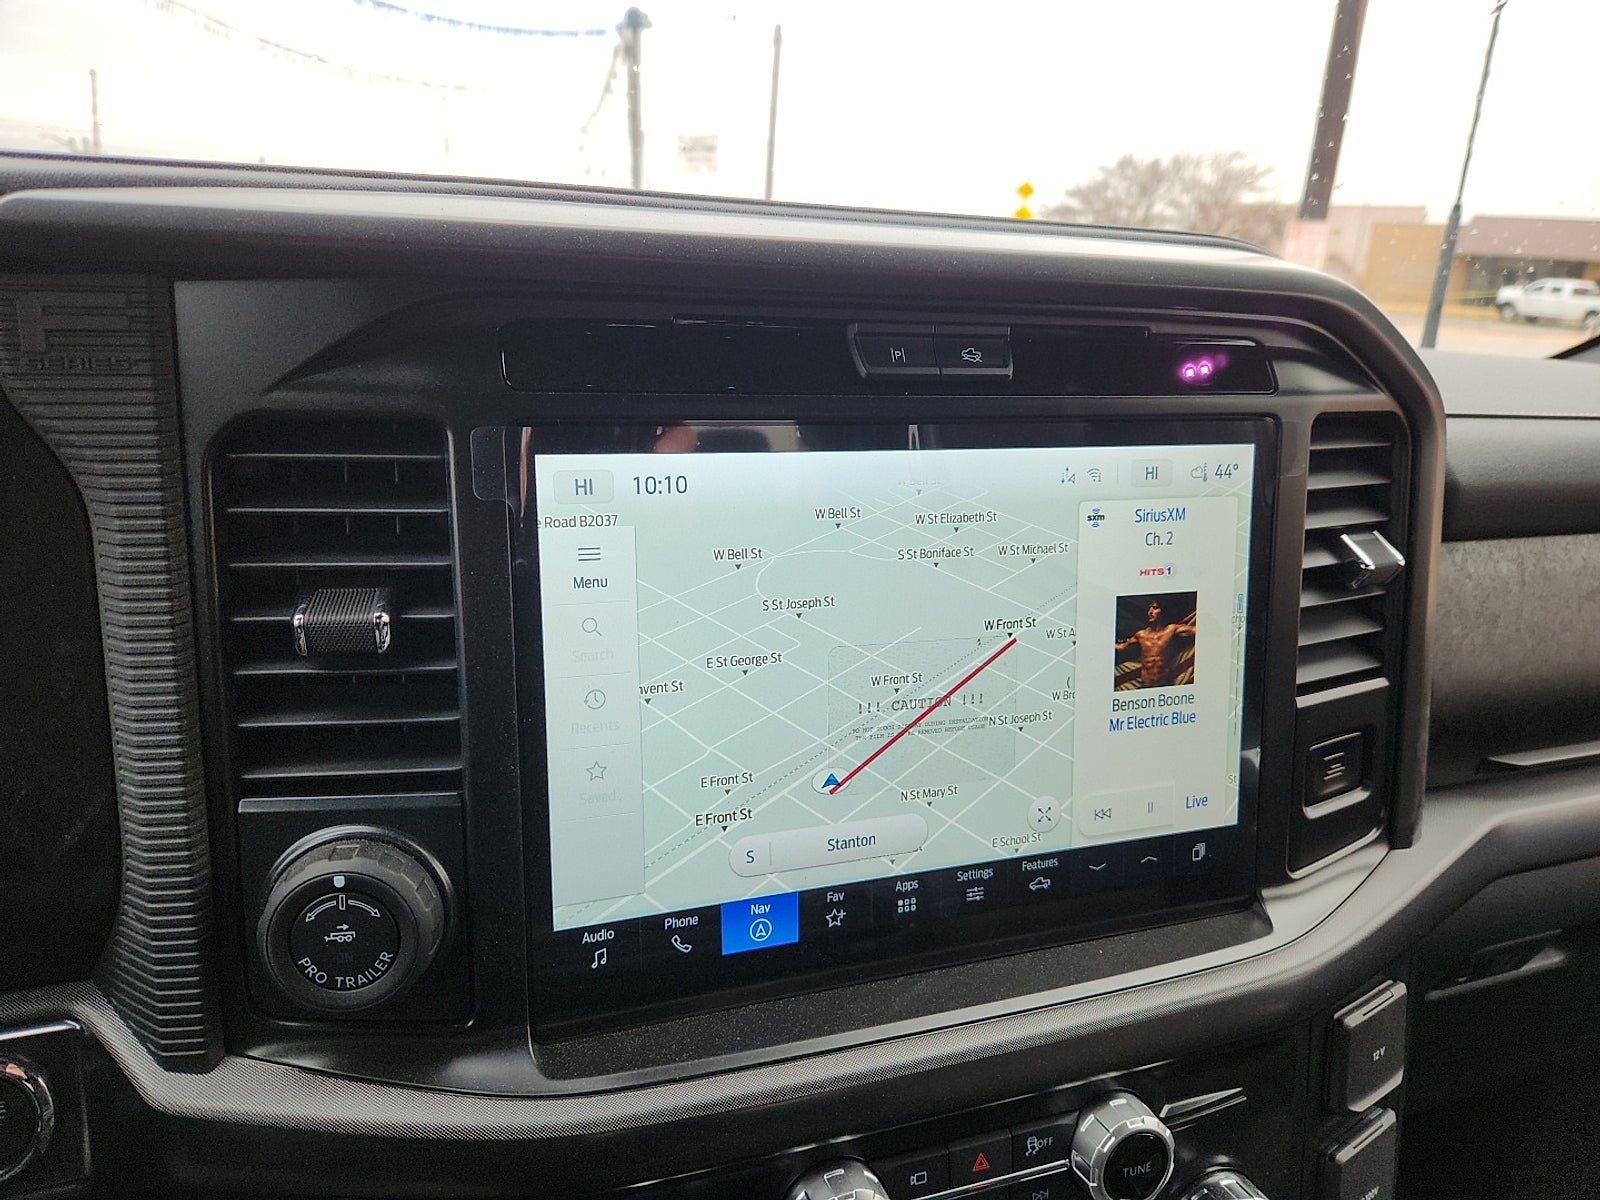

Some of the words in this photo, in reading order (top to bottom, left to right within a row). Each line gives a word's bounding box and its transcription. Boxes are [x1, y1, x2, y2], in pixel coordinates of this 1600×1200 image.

[1145, 466, 1158, 480] HI
[1214, 463, 1239, 479] 44°
[575, 478, 593, 495] HI
[633, 475, 688, 495] 10:10
[814, 508, 825, 519] W
[827, 507, 848, 519] Bell
[850, 506, 862, 518] St
[915, 513, 926, 525] W
[928, 513, 939, 524] St
[941, 512, 985, 524] Elizabeth
[986, 511, 998, 522] St
[1087, 513, 1105, 522] sxm
[1134, 507, 1186, 523] SiriusXM
[544, 515, 577, 529] Road
[579, 514, 618, 528] B2037
[1145, 532, 1164, 546] Ch.
[1166, 531, 1174, 545] 2
[713, 549, 726, 561] W
[727, 548, 749, 560] Bell
[750, 547, 763, 559] St
[898, 549, 904, 560] S
[906, 549, 918, 560] St
[920, 547, 961, 559] Boniface
[963, 546, 975, 557] St
[998, 544, 1009, 555] W
[1010, 544, 1021, 555] St
[1023, 543, 1056, 554] Michael
[1058, 542, 1069, 553] St
[573, 576, 608, 590] Menu
[763, 600, 769, 611] S
[771, 600, 784, 611] St
[785, 597, 820, 612] Joseph
[822, 596, 836, 608] St
[984, 619, 996, 631] W
[997, 618, 1023, 630] Front
[1025, 617, 1037, 628] St
[1046, 629, 1056, 639] W
[1057, 628, 1067, 638] St
[1068, 627, 1076, 637] A
[706, 657, 714, 669] E
[717, 657, 729, 668] St
[731, 654, 768, 669] George
[771, 652, 783, 664] St
[671, 680, 684, 692] St
[871, 676, 883, 687] W
[883, 674, 910, 686] Front
[911, 672, 923, 683] St
[1052, 690, 1061, 701] W
[1112, 697, 1156, 713] Benson
[1157, 694, 1195, 709] Boone
[988, 715, 996, 726] N
[997, 714, 1008, 726] St
[1009, 712, 1040, 726] Joseph
[1041, 711, 1053, 721] St
[1109, 718, 1125, 732] Mr
[1127, 715, 1170, 731] Electric
[1171, 711, 1196, 726] Blue
[701, 778, 708, 789] E
[710, 775, 741, 787] Front
[742, 772, 753, 783] St
[1227, 774, 1237, 784] St
[900, 790, 908, 801] N
[910, 790, 921, 800] St
[923, 787, 946, 802] Mary
[947, 785, 959, 796] St
[1185, 794, 1208, 809] Live
[695, 814, 703, 826] E
[705, 811, 738, 825] Front
[739, 808, 753, 820] St
[827, 834, 876, 852] Stanton
[992, 837, 998, 848] E
[1000, 834, 1030, 847] School
[1031, 832, 1041, 843] St
[746, 850, 755, 863] S
[1021, 857, 1059, 871] Features
[956, 868, 994, 884] Settings
[895, 880, 919, 894] Apps
[827, 891, 845, 903] Fav
[750, 903, 771, 916] Nav
[664, 914, 699, 930] Phone
[582, 929, 615, 944] Audio
[298, 957, 328, 984] PRO
[335, 951, 394, 988] TRAILER
[1372, 1046, 1386, 1062] 12V
[1037, 1136, 1054, 1149] OFF
[1122, 1162, 1152, 1178] TUNE
